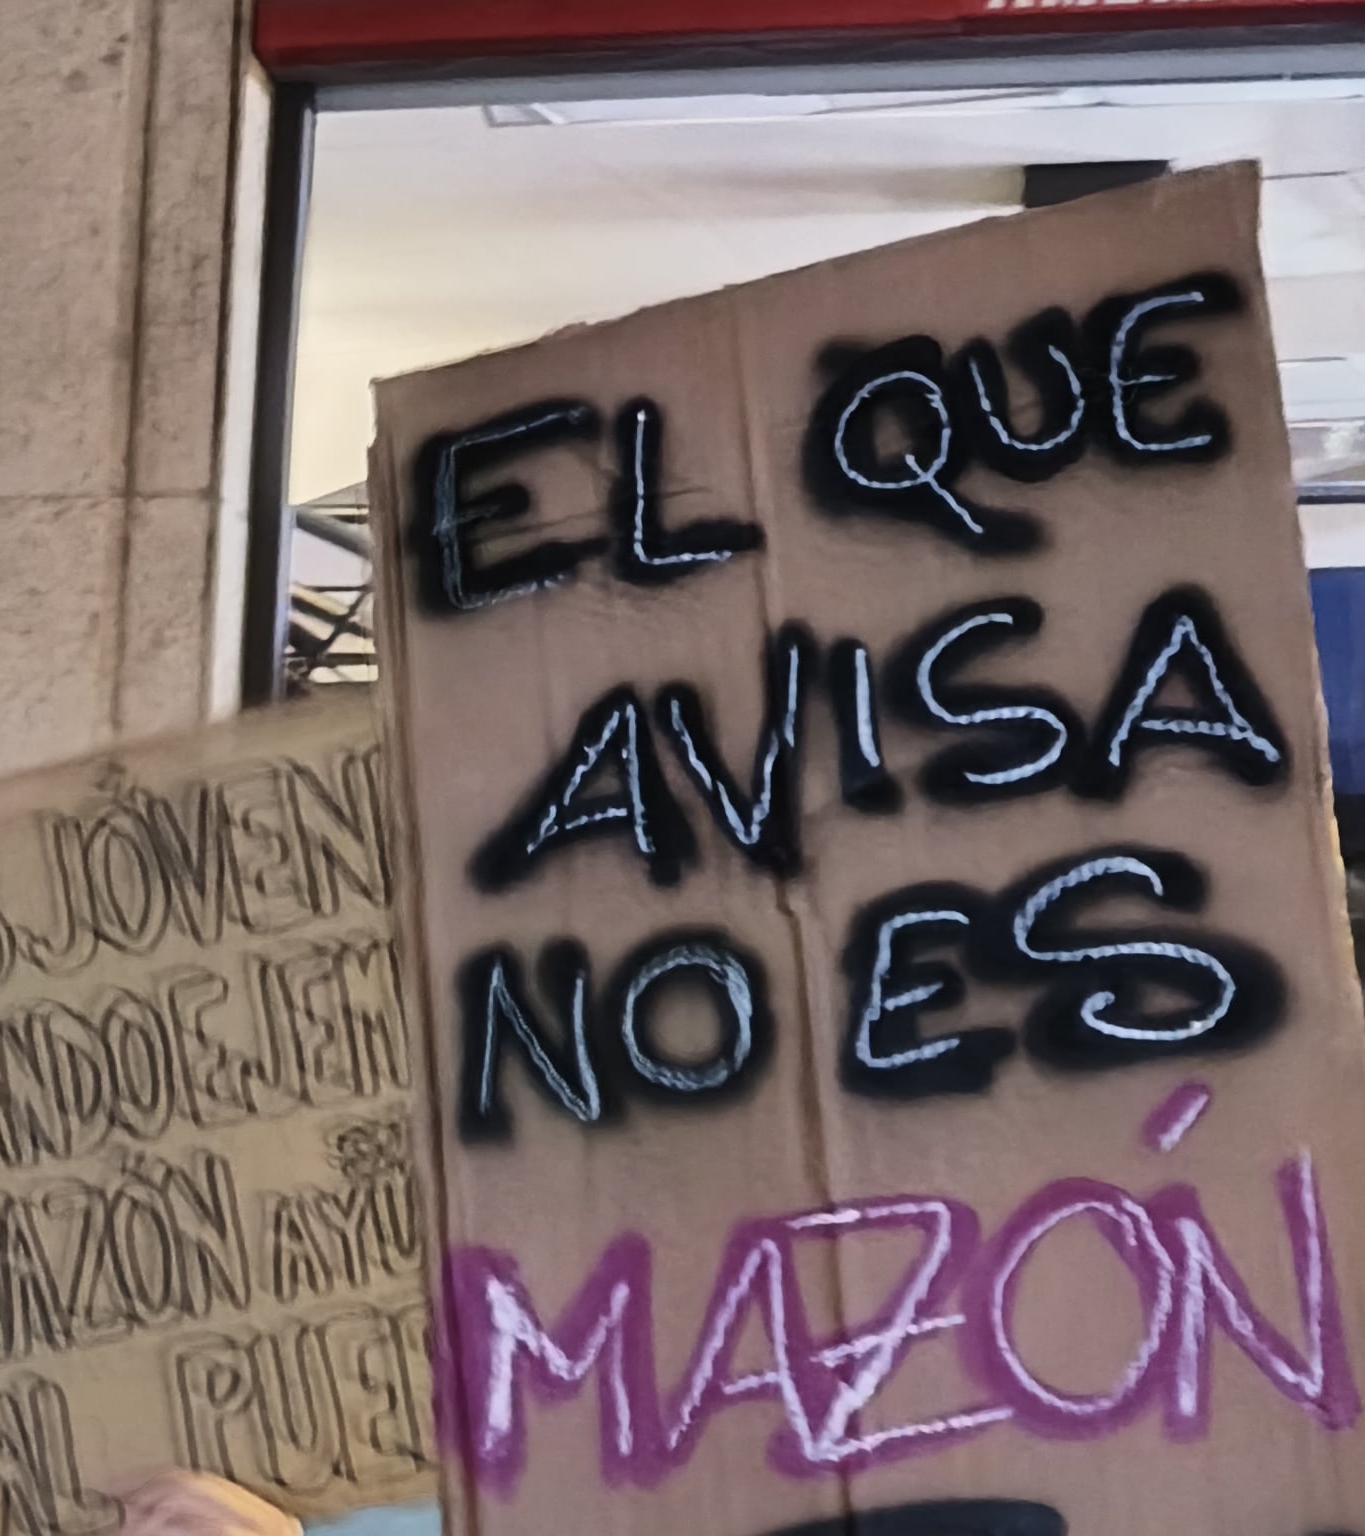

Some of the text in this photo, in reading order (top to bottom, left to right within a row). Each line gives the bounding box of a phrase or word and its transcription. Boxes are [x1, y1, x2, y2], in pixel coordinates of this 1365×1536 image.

[409, 274, 1243, 618] EL QUE
[472, 586, 1291, 890] AVISA
[459, 848, 1287, 1145] NO ES
[449, 1082, 1359, 1500] MAZÓN
